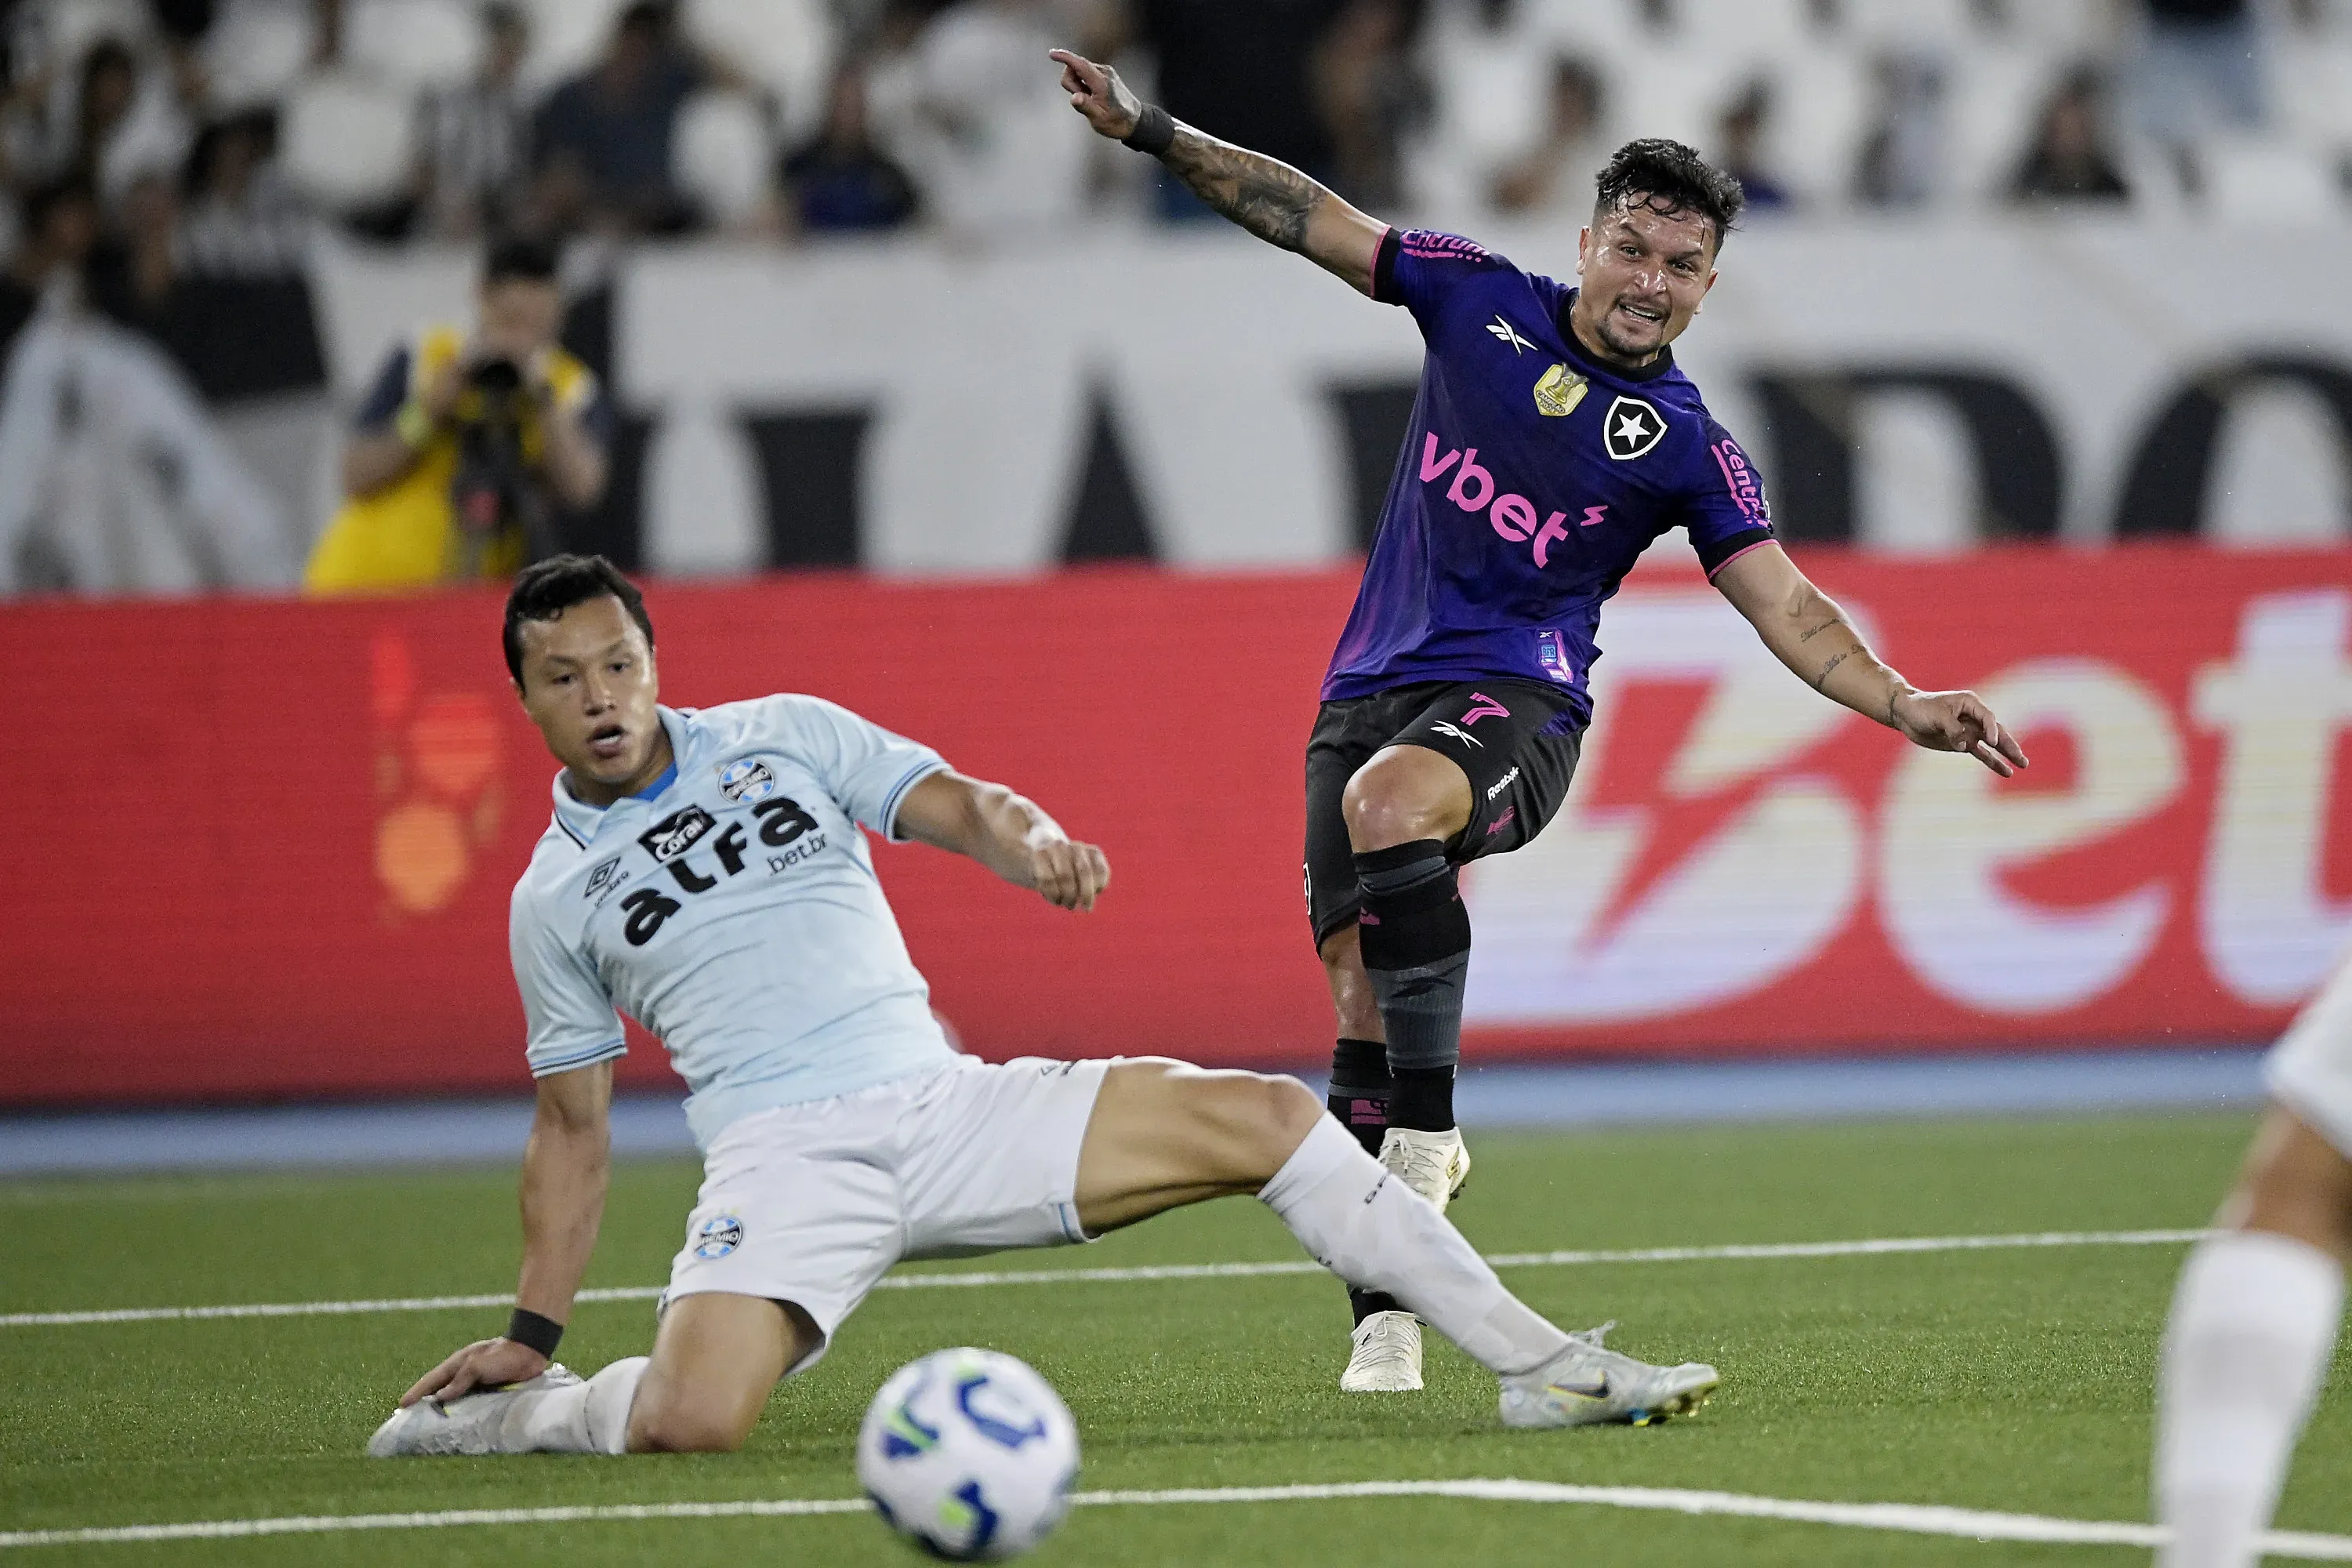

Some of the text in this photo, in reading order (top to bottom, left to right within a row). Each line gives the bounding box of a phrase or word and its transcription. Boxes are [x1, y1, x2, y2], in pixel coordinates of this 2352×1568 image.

[1419, 430, 1569, 569] vbet
[1460, 691, 1511, 726] 7
[655, 818, 703, 862] Coral
